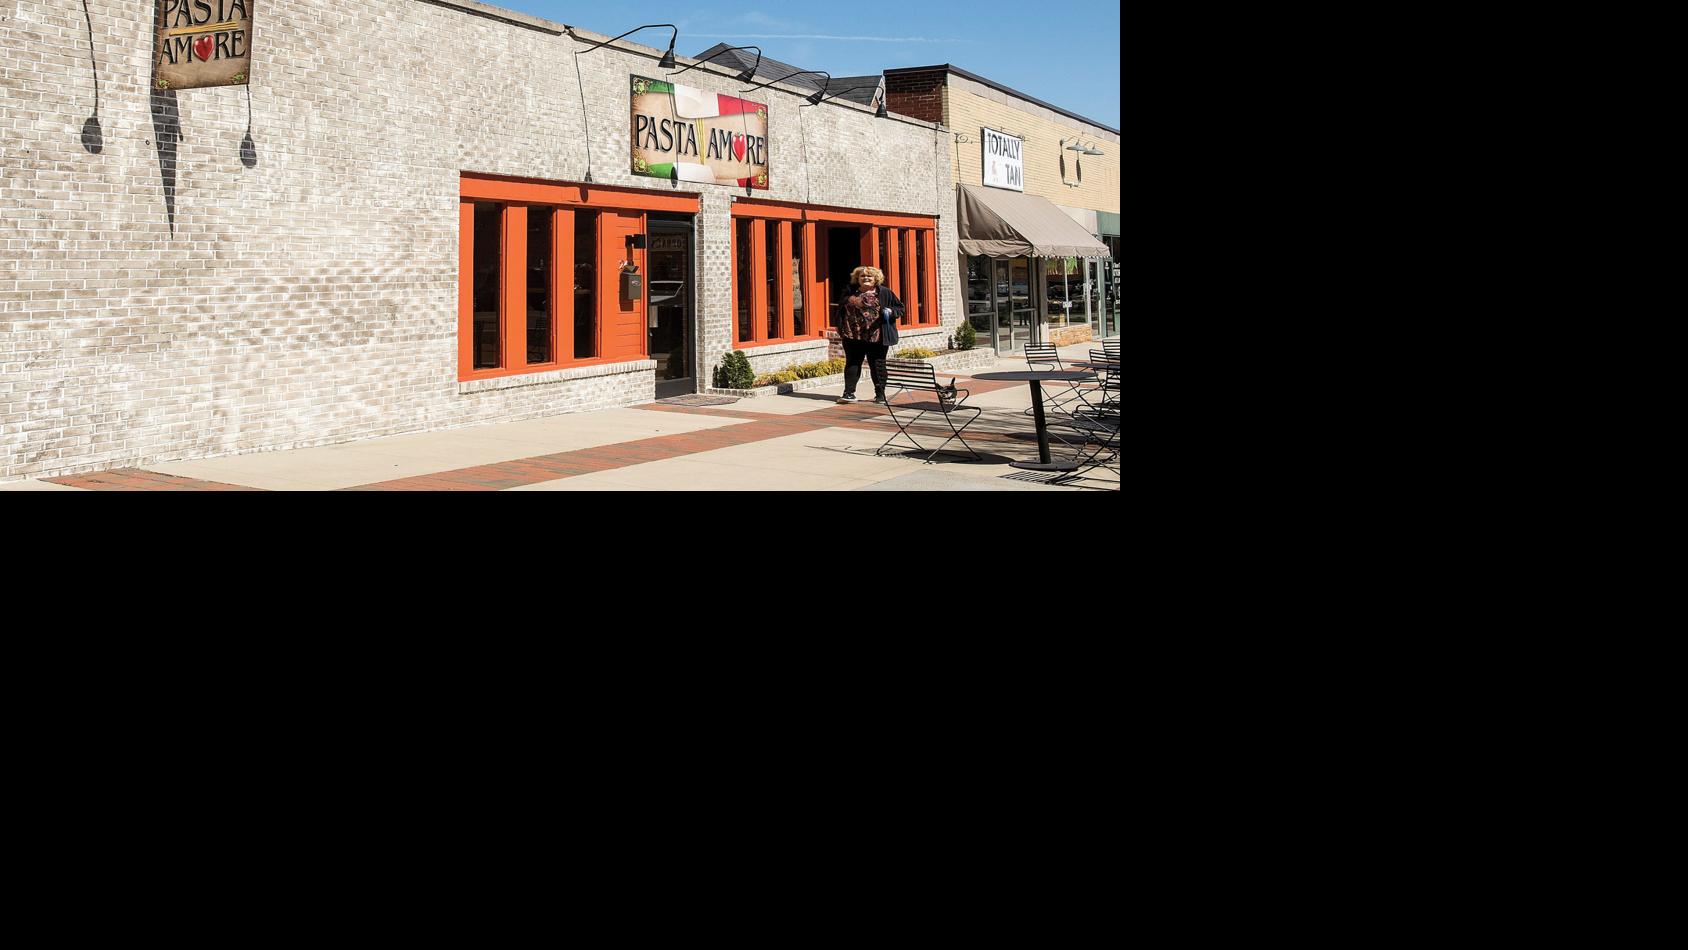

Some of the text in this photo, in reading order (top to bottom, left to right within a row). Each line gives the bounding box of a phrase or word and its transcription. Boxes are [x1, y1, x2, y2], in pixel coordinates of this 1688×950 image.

[635, 114, 698, 156] PASTA
[987, 132, 1020, 160] TOTALLY
[1005, 163, 1021, 187] TAN
